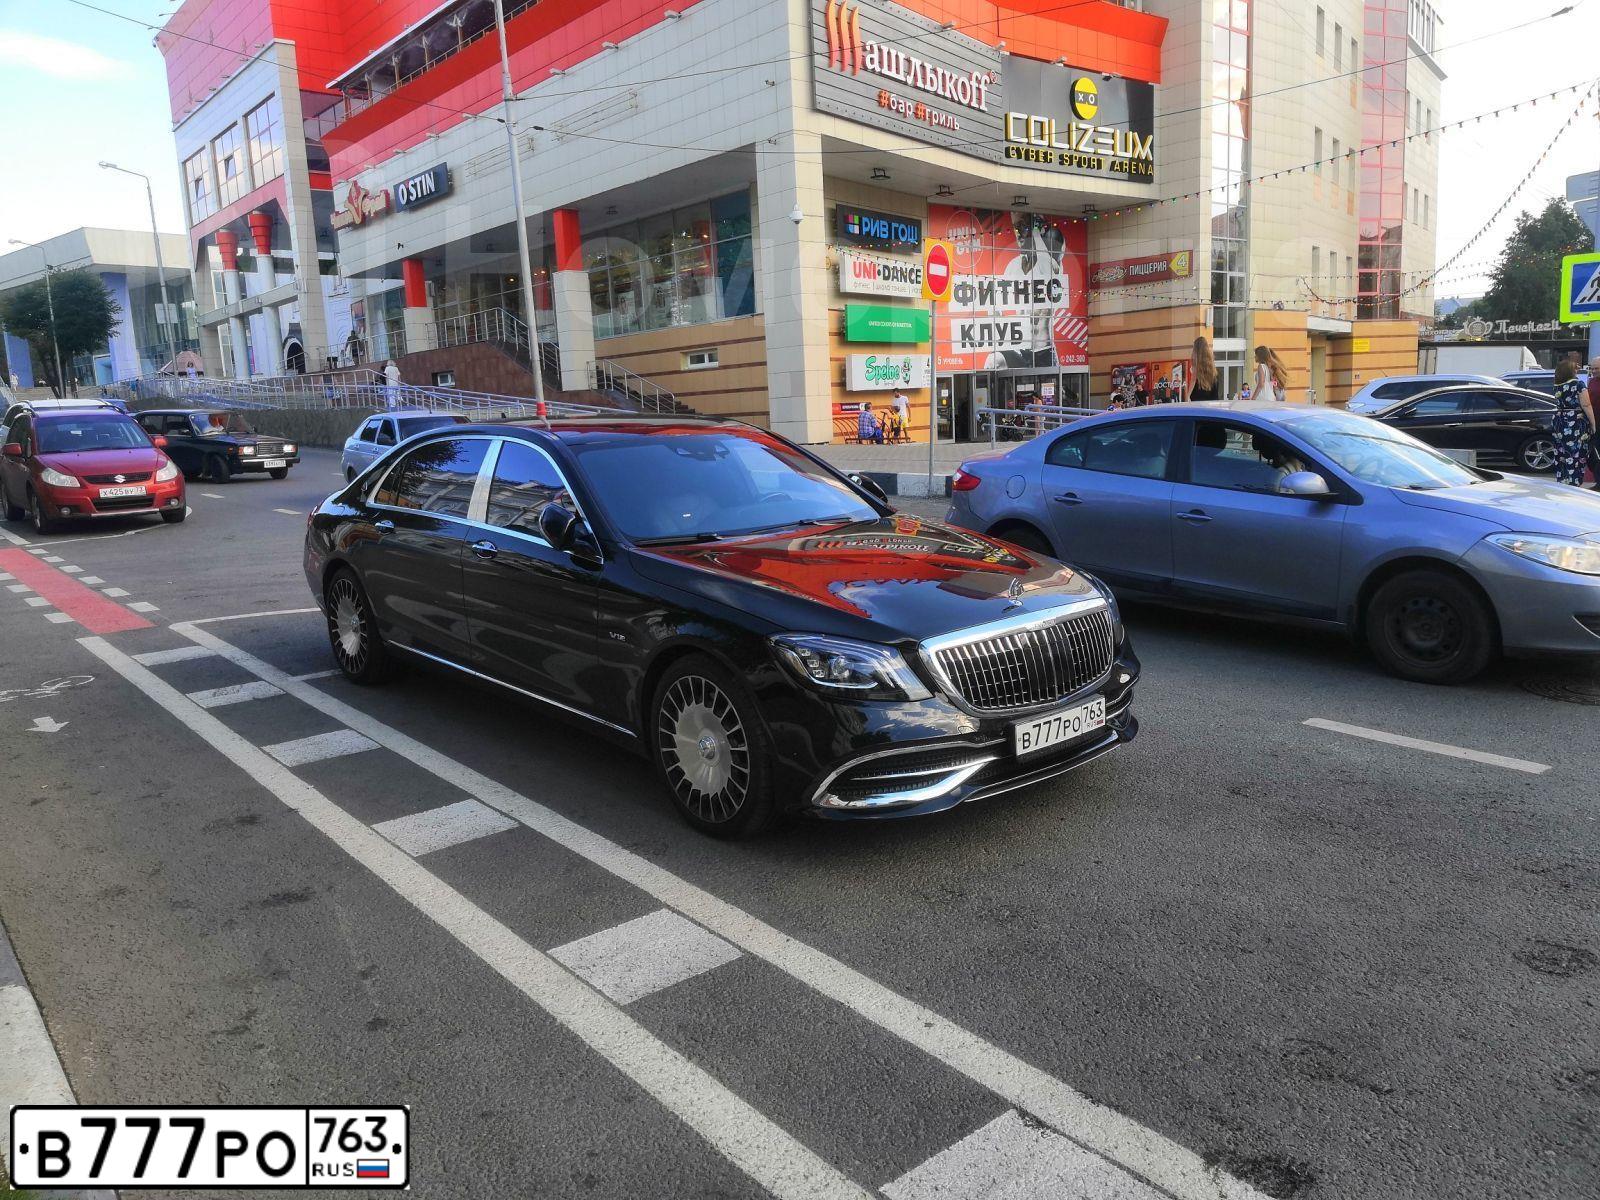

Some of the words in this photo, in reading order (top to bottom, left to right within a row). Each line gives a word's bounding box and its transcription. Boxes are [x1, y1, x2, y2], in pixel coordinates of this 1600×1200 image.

[1007, 145, 1054, 163] CYBER
[1062, 152, 1105, 170] SPORT
[1113, 160, 1154, 176] ARENA
[862, 217, 889, 239] РИВ
[891, 222, 918, 243] ГОШ
[1129, 260, 1167, 276] ПИЦЦЕРИЯ
[1178, 254, 1186, 268] 4
[953, 278, 1063, 307] ФИТНЕС
[960, 321, 1024, 349] КЛУБ
[1083, 701, 1103, 723] 763
